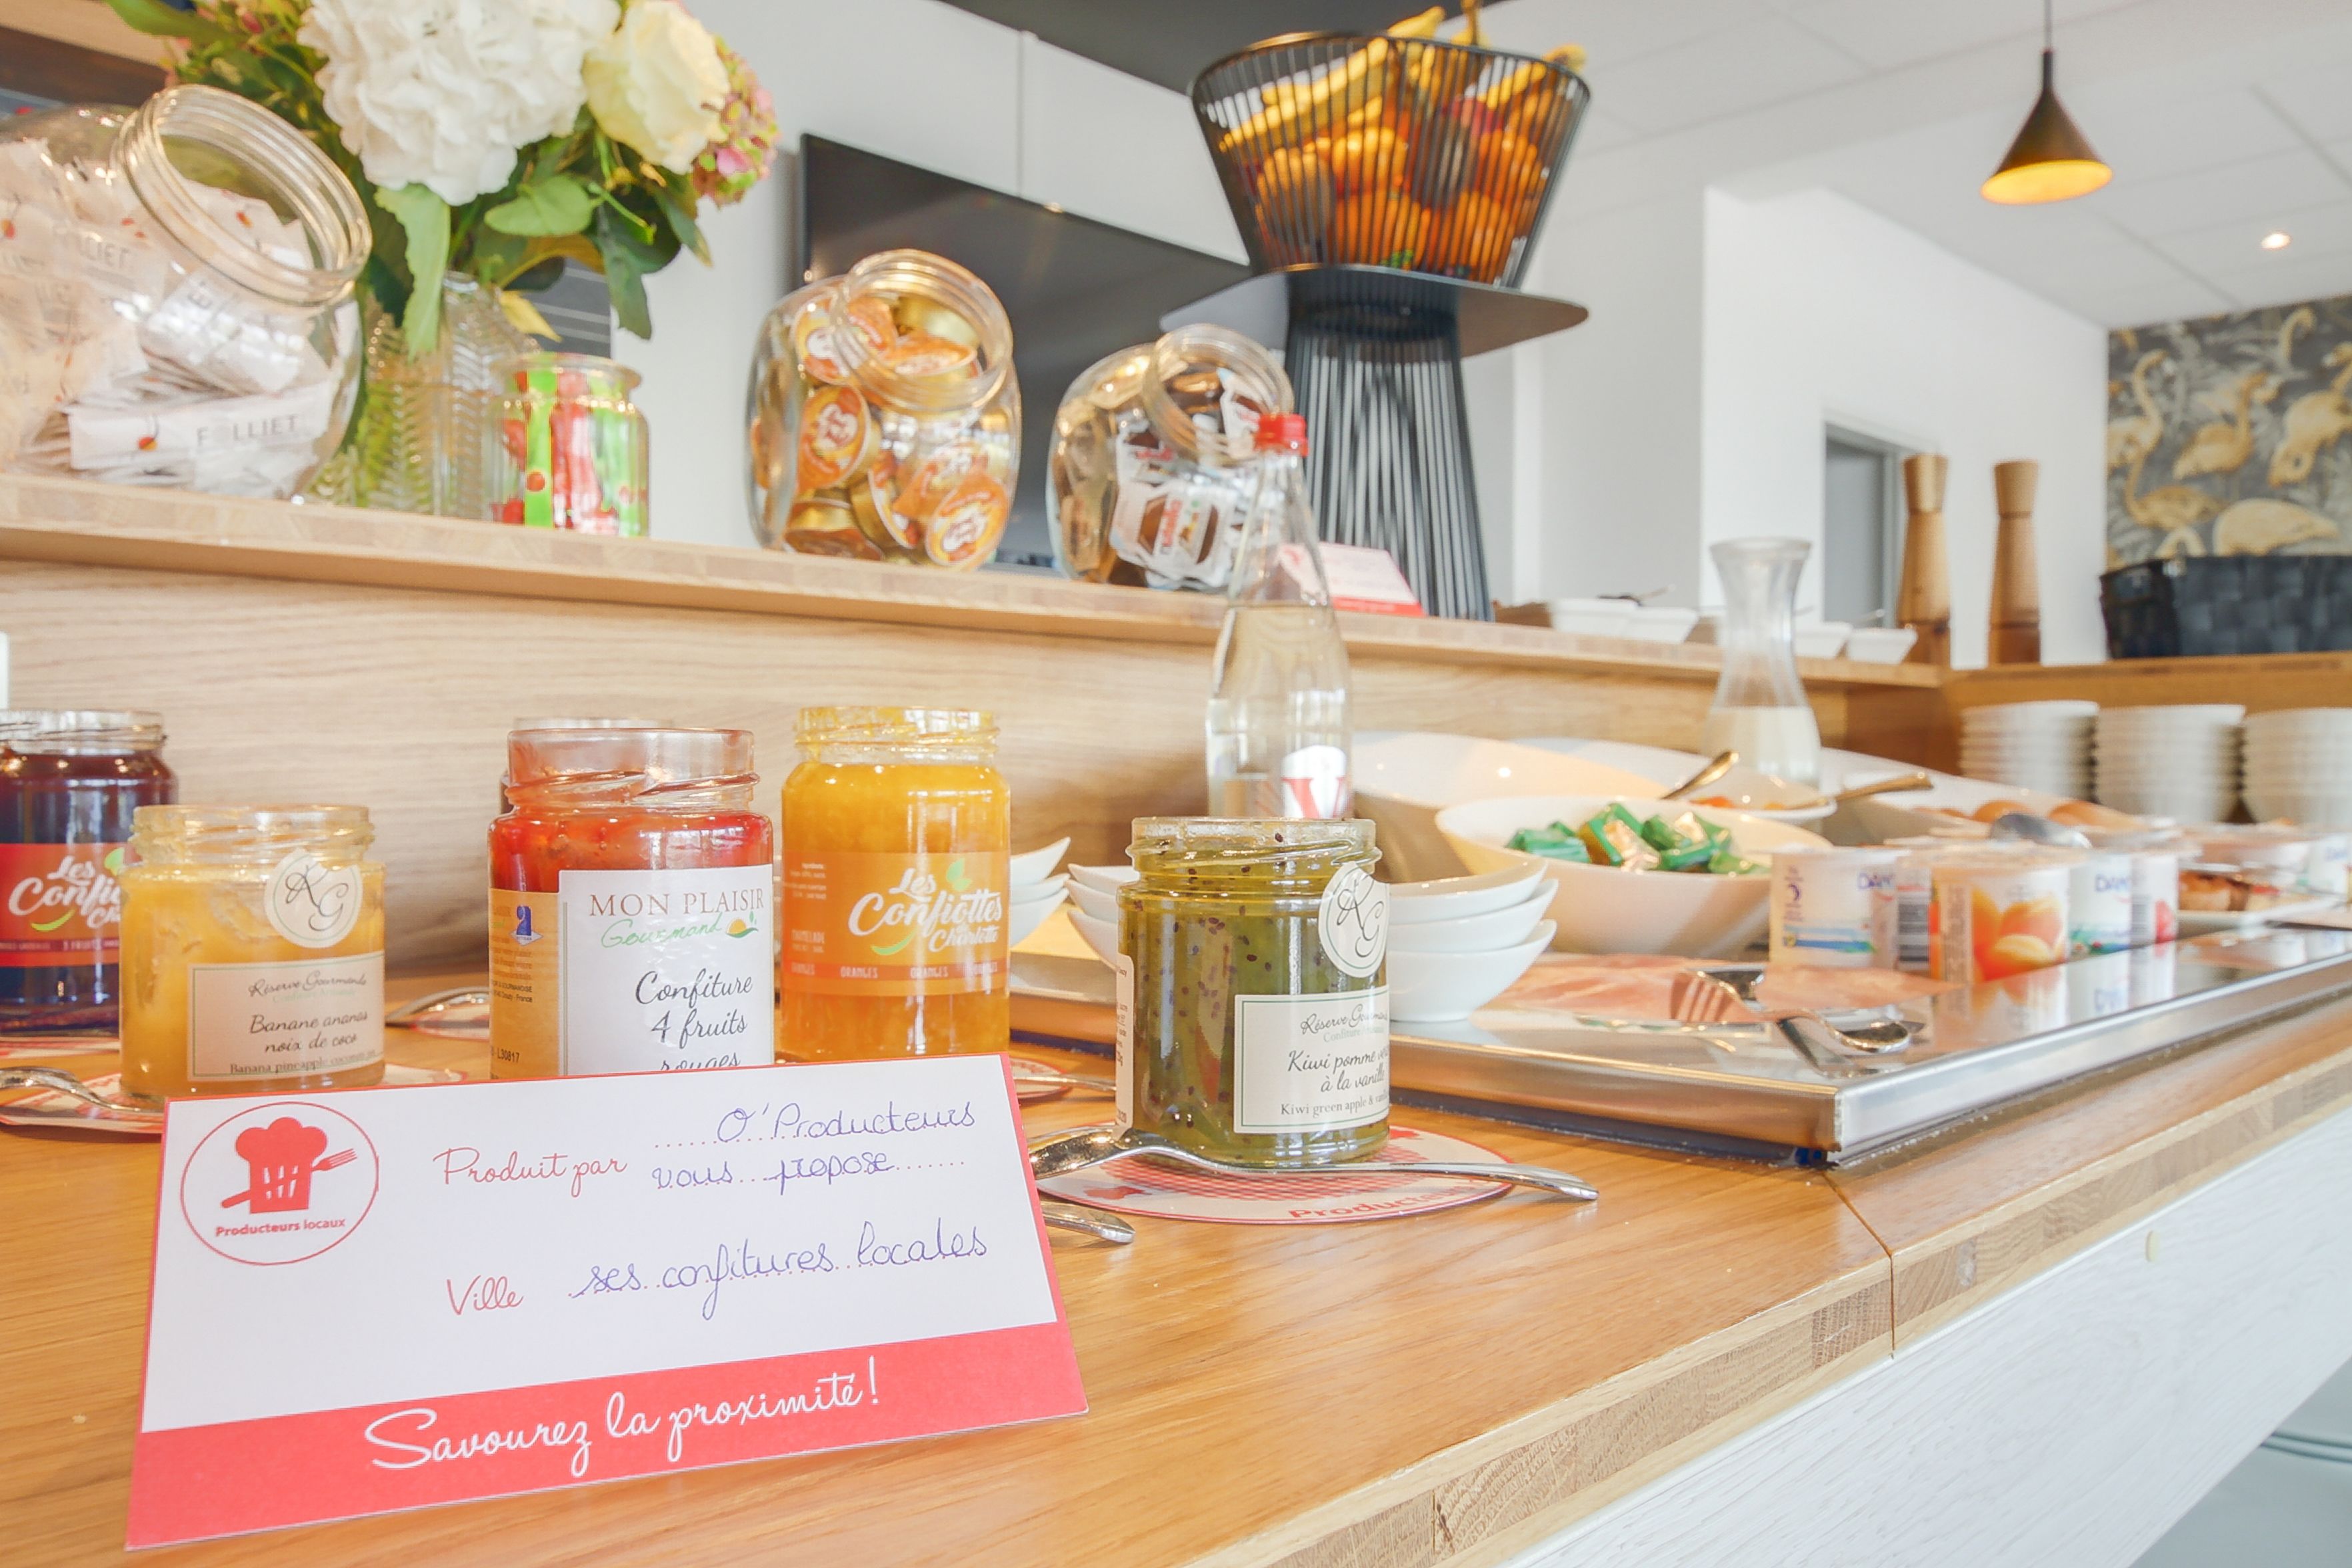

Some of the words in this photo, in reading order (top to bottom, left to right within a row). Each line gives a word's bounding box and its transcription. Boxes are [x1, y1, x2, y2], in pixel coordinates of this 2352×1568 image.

[47, 855, 96, 886] Les
[888, 868, 937, 903] Les
[589, 893, 669, 916] MON
[683, 888, 765, 915] PLAISIR
[848, 888, 1002, 938] Confiottes
[601, 911, 723, 949] Gourmand
[635, 968, 753, 1009] Confiture
[840, 967, 879, 979] ORANGES
[249, 1014, 319, 1033] Banane
[323, 1011, 369, 1027] ananas
[651, 1010, 671, 1043] 4
[679, 1008, 748, 1049] fruits
[1300, 1013, 1349, 1035] Réserve
[265, 1038, 301, 1053] noix
[308, 1032, 327, 1049] de
[332, 1034, 357, 1047] coco
[230, 1063, 271, 1074] Banana
[1287, 1050, 1331, 1072] Kiwi
[1333, 1051, 1375, 1073] pomme
[1320, 1076, 1333, 1093] à
[1337, 1070, 1352, 1091] la
[1281, 1103, 1310, 1116] Kiwi
[1313, 1103, 1343, 1119] green
[1345, 1097, 1367, 1114] apple
[1369, 1095, 1374, 1105] &
[433, 1147, 567, 1185] Produit
[571, 1158, 628, 1198] par
[651, 1161, 733, 1189] vous
[767, 1152, 895, 1195] propose
[215, 1223, 300, 1237] Producteurs
[303, 1218, 346, 1229] locaux
[571, 1263, 641, 1298] ses
[662, 1238, 835, 1320] confitures
[857, 1217, 987, 1265] locales
[446, 1274, 523, 1315] Ville
[365, 1407, 591, 1477] Savourez
[605, 1391, 661, 1437] la
